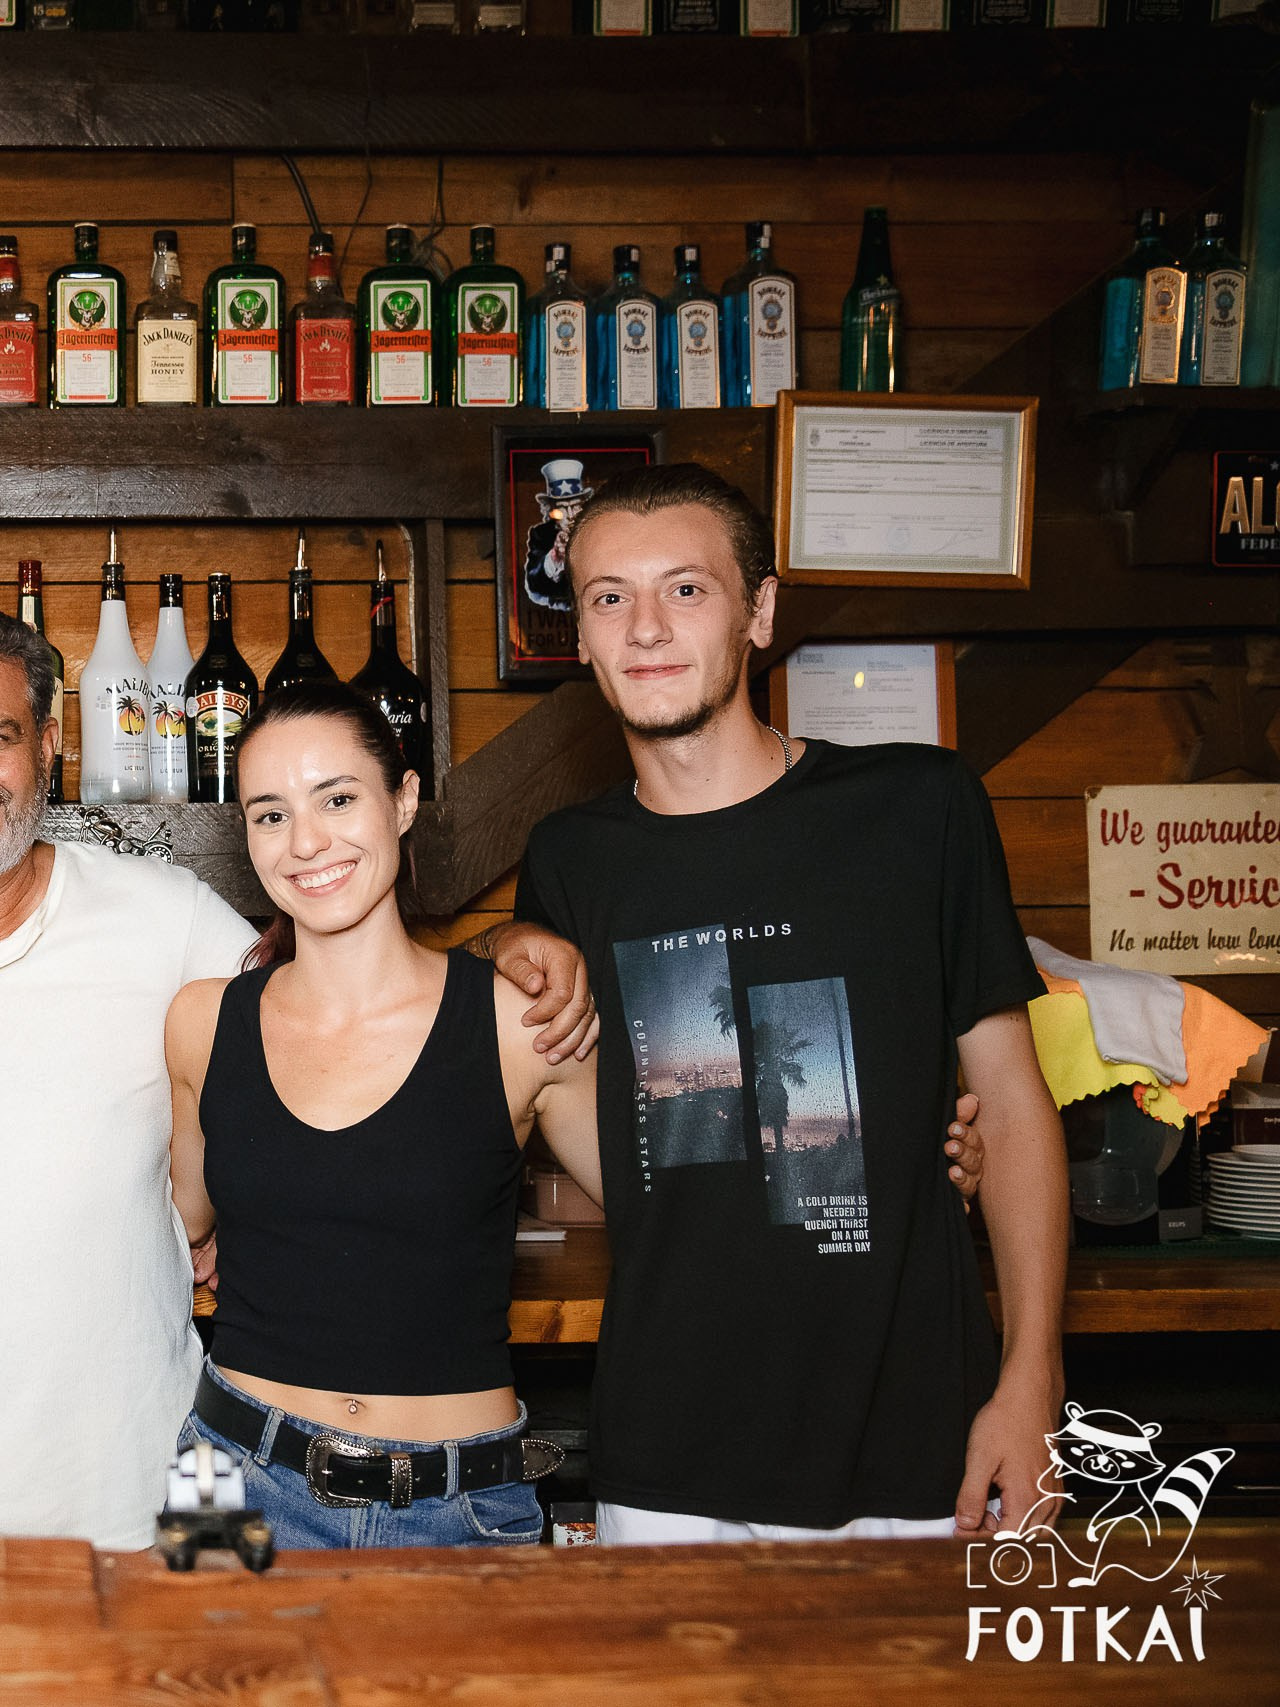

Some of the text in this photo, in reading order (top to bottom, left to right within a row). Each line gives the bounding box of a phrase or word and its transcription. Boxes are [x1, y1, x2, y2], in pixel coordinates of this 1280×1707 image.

[143, 331, 162, 346] JACK
[527, 634, 554, 649] FOR
[1100, 808, 1145, 846] We
[651, 922, 792, 953] THE WORLDS
[1109, 929, 1136, 952] No
[1143, 930, 1200, 952] matter
[1208, 927, 1241, 950] how
[632, 1019, 652, 1194] COUNTLESS STARS
[797, 1195, 868, 1207] A COLD DRINK IS
[823, 1206, 869, 1218] NEEDED TO
[804, 1218, 868, 1231] QUENCH THIRST
[831, 1229, 869, 1241] ON A HOT
[817, 1241, 871, 1254] SUMMER DAY
